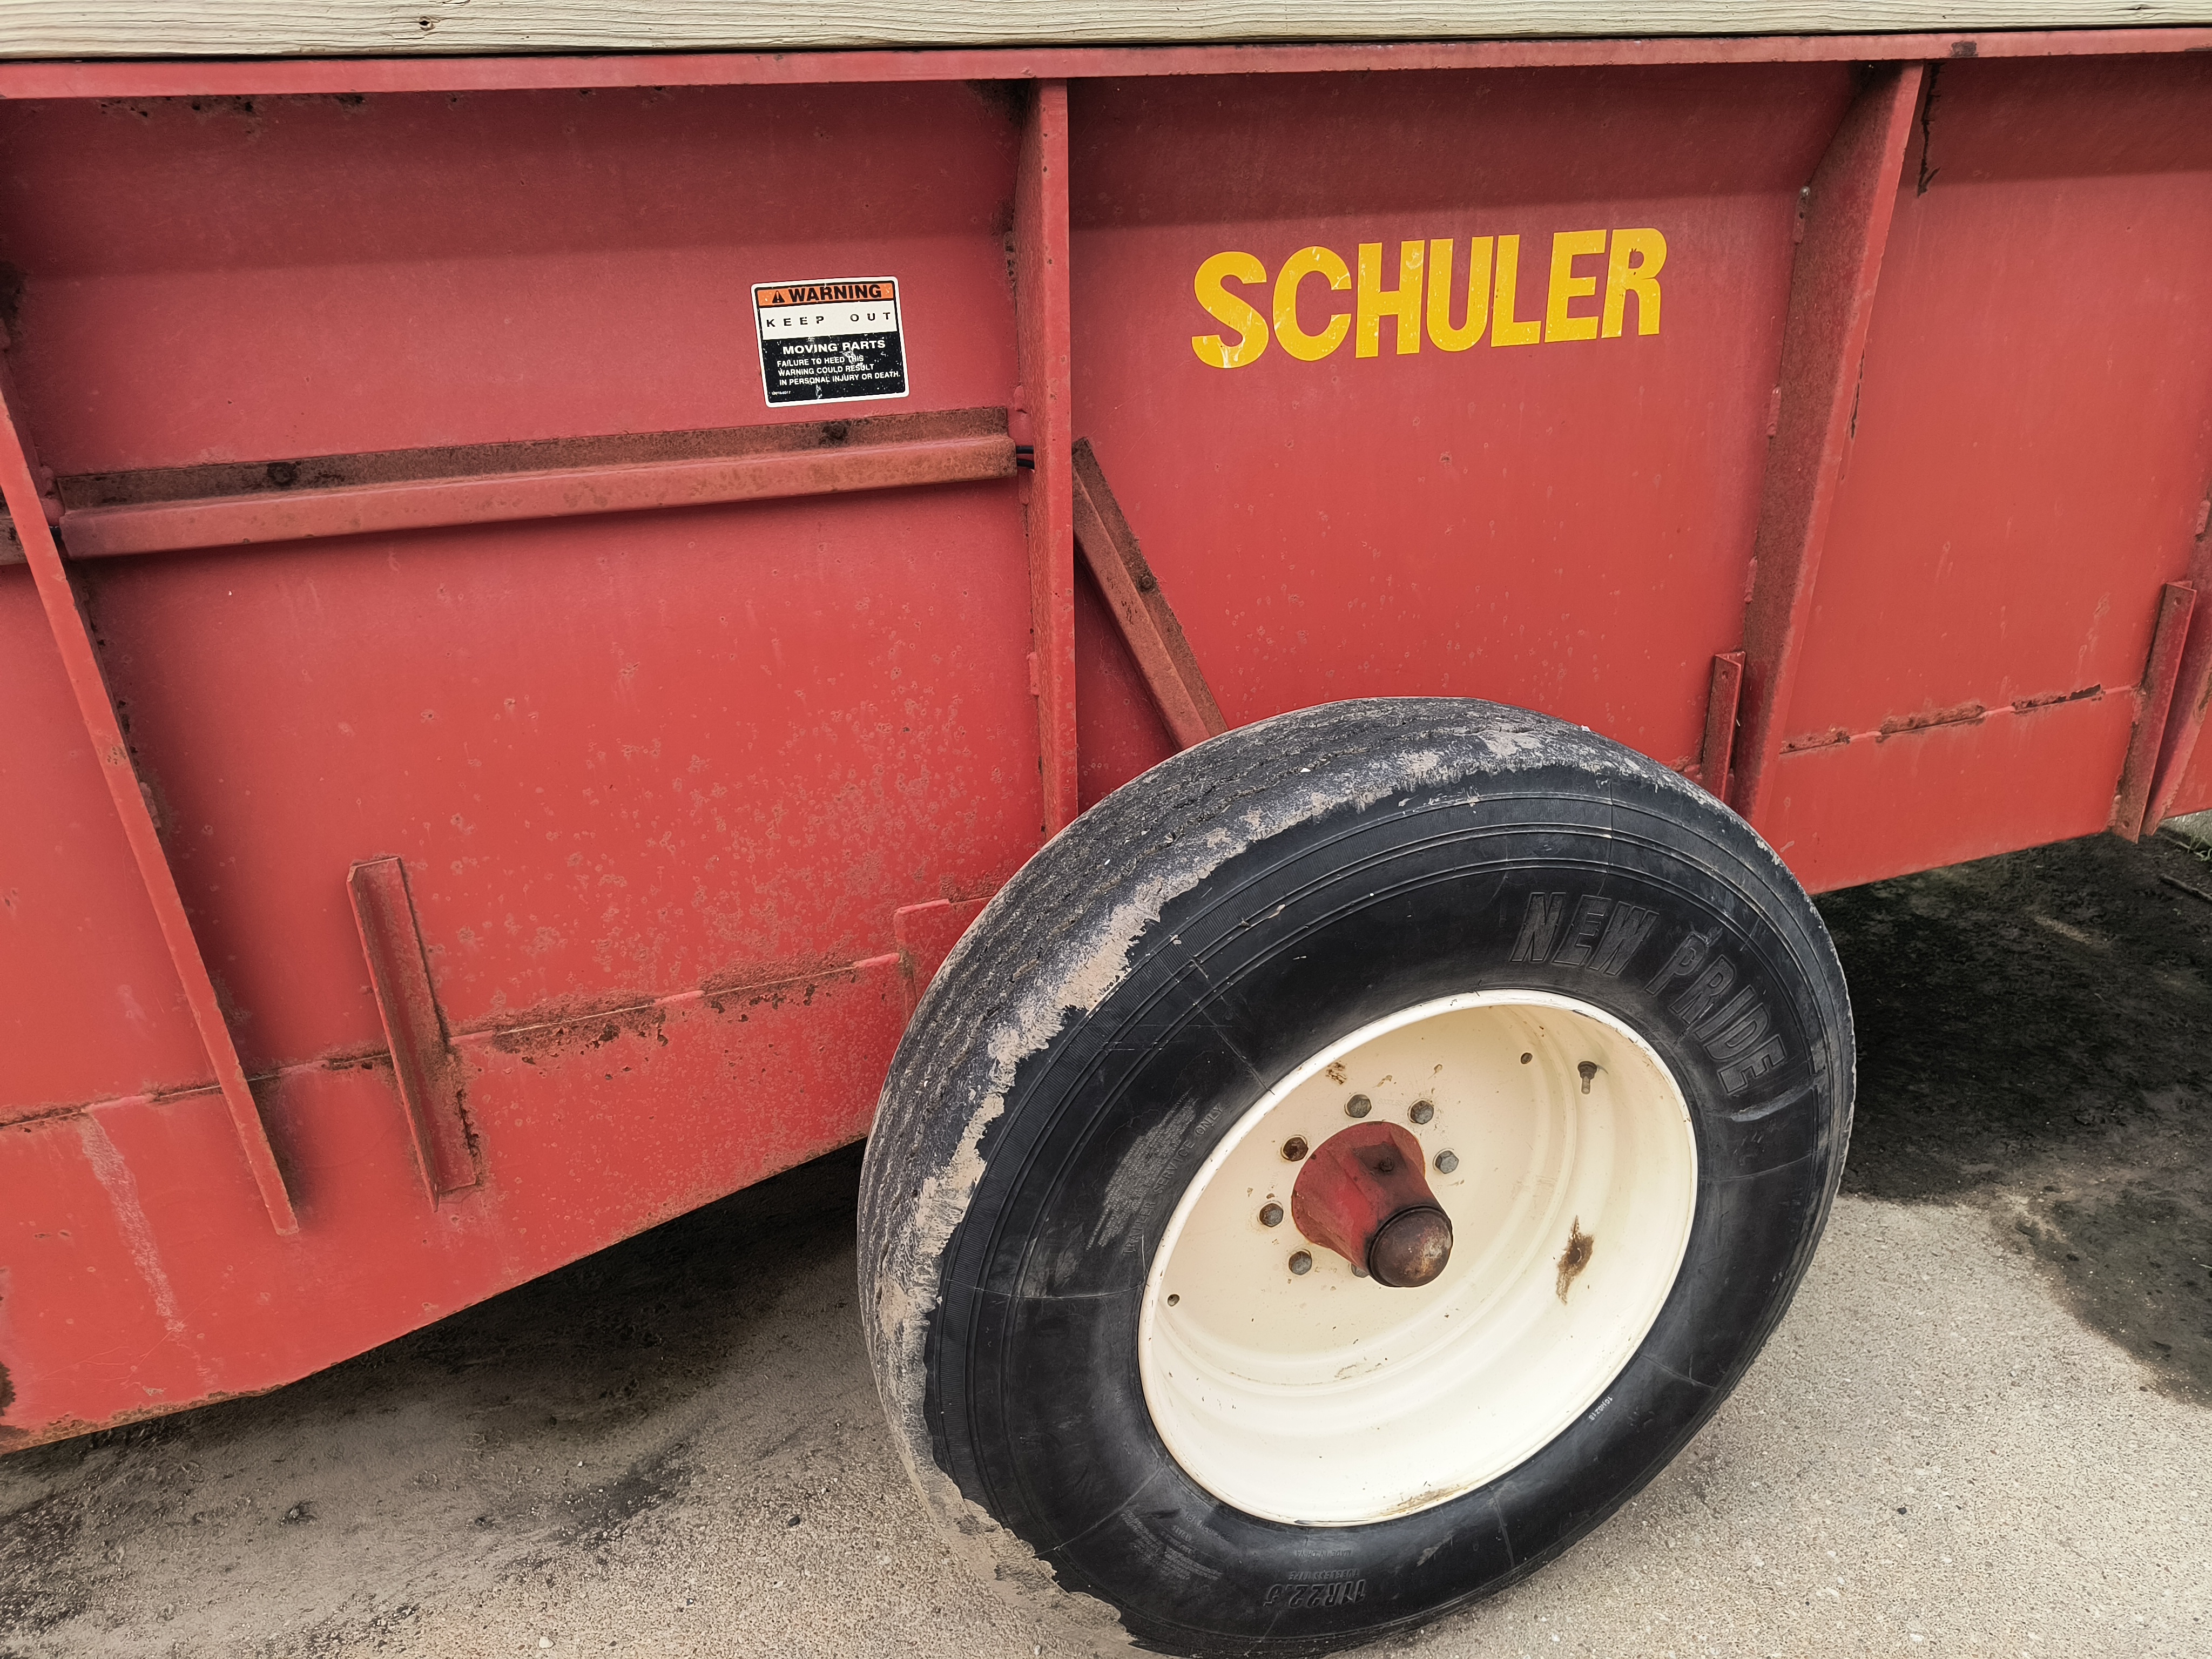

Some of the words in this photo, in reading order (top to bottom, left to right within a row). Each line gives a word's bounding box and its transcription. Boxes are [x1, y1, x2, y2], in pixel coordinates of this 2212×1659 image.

[789, 284, 881, 303] WARNING
[1190, 227, 1667, 369] SCHULER
[766, 316, 824, 327] KEEP
[850, 312, 890, 322] OUT
[783, 344, 838, 354] MOVING
[842, 340, 885, 351] PARTS
[777, 359, 809, 367] FAILURE
[845, 363, 874, 372] RESULT
[789, 376, 830, 385] PERSONAL
[832, 374, 859, 383] INJURY
[874, 371, 900, 379] DEATH.
[1509, 892, 1660, 976] NEW
[1644, 930, 1786, 1095] PRIDE
[1122, 1201, 1156, 1254] TRAILER
[1153, 1139, 1195, 1194] SERVICE
[1195, 1104, 1223, 1136] ONLY
[1331, 1549, 1351, 1557] MADE
[1287, 1570, 1311, 1580] TYPE
[1313, 1568, 1359, 1580] TUBELESS
[1262, 1578, 1366, 1609] 11R22.5
